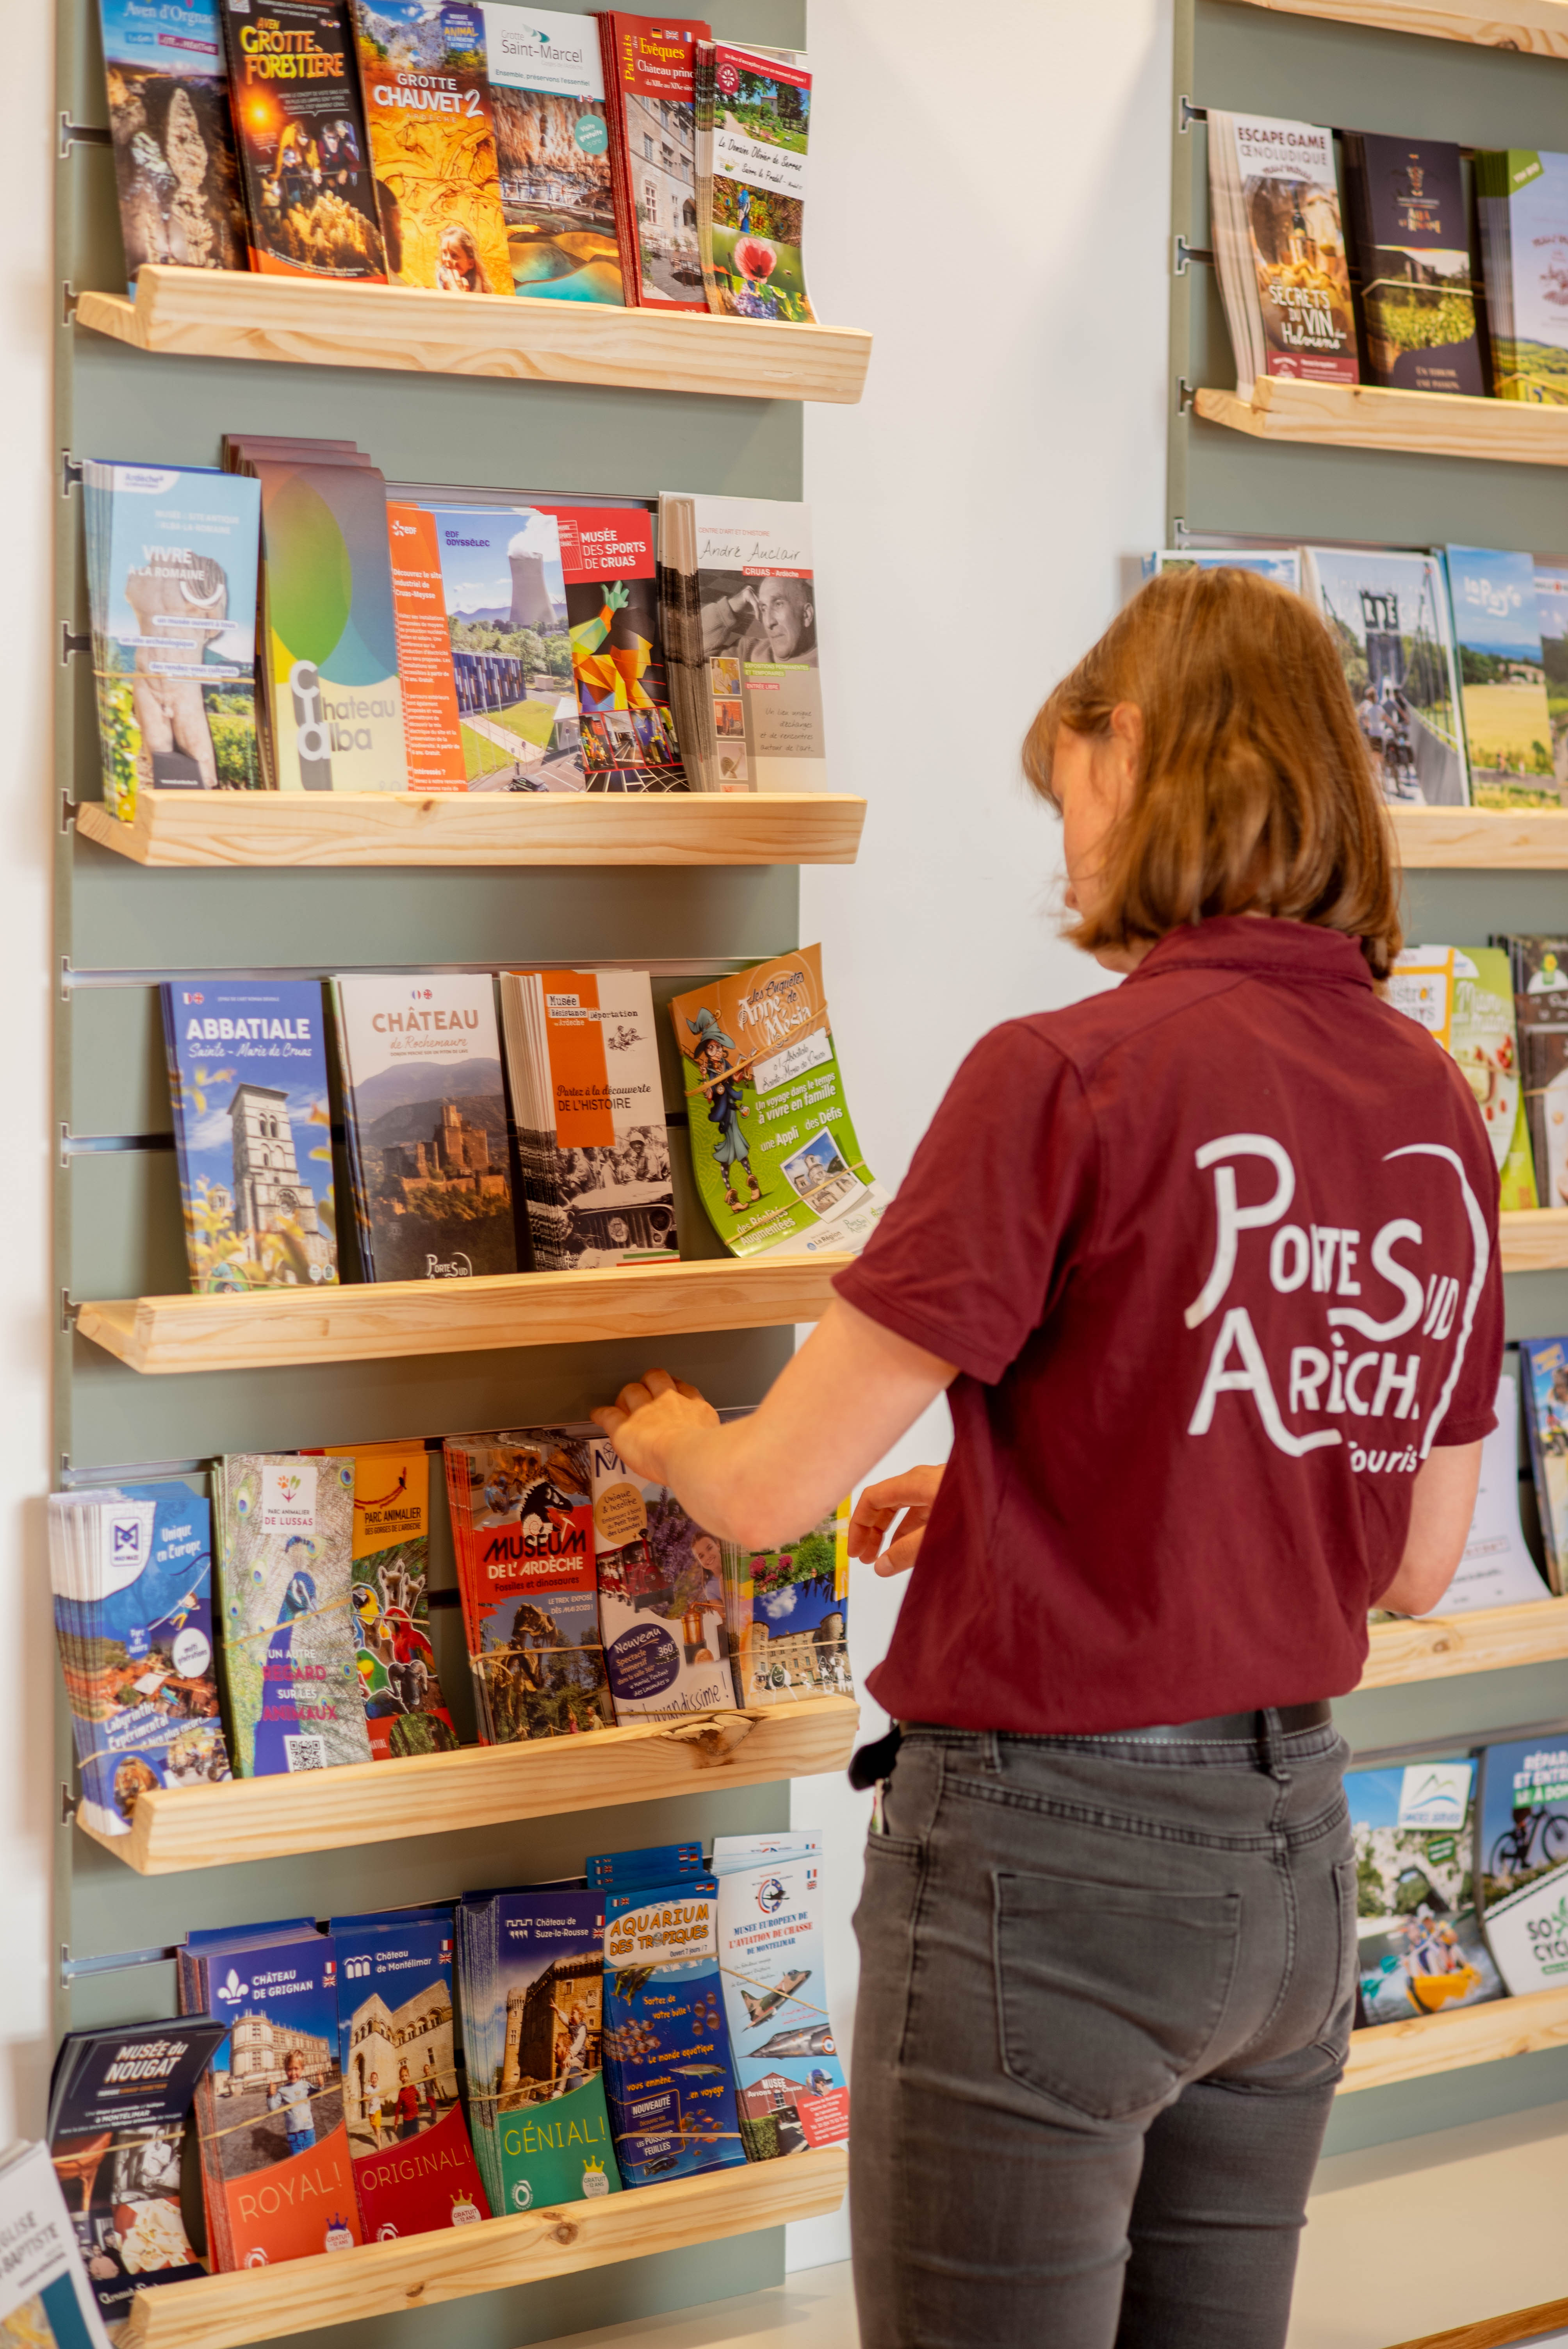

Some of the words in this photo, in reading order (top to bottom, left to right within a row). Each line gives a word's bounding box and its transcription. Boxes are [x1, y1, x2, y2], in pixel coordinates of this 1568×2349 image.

[123, 1, 156, 18] Aven
[160, 4, 214, 27] d'Orgnac
[256, 17, 281, 30] AVEN
[444, 27, 479, 37] ANIMAL
[240, 25, 316, 53] GROTTE
[501, 29, 525, 41] Grotte
[502, 39, 583, 63] Saint-Marcel
[622, 33, 635, 82] Palais
[495, 69, 525, 79] Ensemble,
[526, 73, 560, 83] préservons
[561, 77, 591, 87] l'essentiel
[636, 59, 672, 76] Château
[672, 66, 695, 79] princ
[397, 73, 457, 90] GROTTE
[374, 85, 463, 113] CHAUVET
[465, 89, 485, 118] 2
[579, 130, 604, 143] gratuite
[580, 123, 596, 132] Visite
[1238, 127, 1285, 145] ESCAPE
[1286, 132, 1326, 149] GAME
[718, 136, 725, 147] Le
[728, 139, 749, 156] Domaine
[751, 146, 771, 162] Olivier
[772, 154, 779, 164] de
[781, 156, 803, 171] Serres
[1269, 284, 1331, 310] SECRETS
[1301, 308, 1334, 338] VIN
[580, 527, 618, 543] MUSÉE
[142, 544, 192, 565] VIVRE
[582, 544, 604, 556] DES
[605, 541, 647, 554] SPORTS
[697, 539, 741, 560] André
[746, 542, 802, 562] Auclair
[584, 558, 599, 569] DE
[600, 555, 636, 568] CRUAS
[138, 566, 152, 577] LA
[155, 566, 205, 581] ROMAINE
[393, 569, 422, 578] Découvrez
[430, 571, 442, 579] site
[745, 568, 771, 577] CRUAS
[775, 569, 799, 578] Ardèche
[394, 579, 421, 588] industriel
[395, 589, 436, 599] Cruas-Meysse
[749, 988, 764, 1005] Les
[766, 971, 805, 997] Enquêtes
[786, 989, 798, 1004] de
[550, 995, 577, 1006] Musée
[372, 1006, 480, 1033] CHÂTEAU
[590, 1011, 638, 1020] Déportation
[738, 995, 782, 1032] Anne
[186, 1018, 311, 1041] ABBATIALE
[189, 1042, 225, 1059] Sainte
[236, 1043, 267, 1057] Marie
[269, 1043, 280, 1057] de
[282, 1042, 312, 1057] Cruas
[390, 1037, 401, 1050] de
[403, 1034, 468, 1050] Rochemaure
[558, 1100, 571, 1112] DE
[573, 1098, 632, 1111] L'HISTOIRE
[805, 1115, 819, 1131] des
[819, 1105, 843, 1125] Défis
[740, 1215, 796, 1246] Augmentées
[426, 1254, 451, 1277] PORTE
[444, 1262, 468, 1278] SUD
[604, 1490, 631, 1504] Unique
[265, 1517, 276, 1525] DE
[280, 1517, 313, 1526] LUSSAS
[365, 1512, 382, 1524] PARC
[384, 1507, 421, 1522] ANIMALIER
[614, 1518, 627, 1527] Petit
[628, 1514, 640, 1523] Train
[161, 1524, 192, 1542] Unique
[365, 1527, 374, 1535] DES
[374, 1526, 391, 1534] GORGES
[157, 1550, 168, 1562] en
[168, 1540, 202, 1560] Europe
[487, 1565, 506, 1579] DE
[519, 1555, 583, 1576] ARDÈCHE
[494, 1581, 525, 1592] Fossiles
[526, 1580, 535, 1589] et
[536, 1576, 580, 1589] dinosaures
[130, 1628, 145, 1637] Parc
[613, 1628, 661, 1654] Nouveau
[128, 1643, 149, 1654] loisirs
[268, 1649, 283, 1659] UN
[286, 1649, 317, 1659] AUTRE
[615, 1649, 647, 1667] Spectacle
[619, 1657, 647, 1675] immersif
[262, 1664, 327, 1682] REGARD
[104, 1702, 156, 1734] Labyrinthe
[262, 1705, 338, 1722] ANIMAUX
[107, 1712, 169, 1751] Expérimental
[1524, 1750, 1568, 1770] RÉPAR
[1513, 1773, 1531, 1788] ET
[1533, 1770, 1568, 1786] ENTR
[535, 1918, 566, 1927] Château
[567, 1917, 576, 1925] de
[610, 1903, 709, 1937] AQUARIUM
[734, 1923, 757, 1937] MUSEE
[759, 1914, 797, 1930] EUROPEEN
[798, 1912, 808, 1921] DE
[535, 1928, 589, 1939] Suze-la-Rousse
[729, 1930, 771, 1950] L'AVIATION
[773, 1928, 782, 1937] DE
[783, 1921, 814, 1936] CHASSE
[1528, 1919, 1553, 1940] SO
[376, 1951, 409, 1962] Château
[1533, 1943, 1568, 1962] CYCL
[377, 1964, 386, 1973] de
[388, 1958, 432, 1972] Montélimar
[252, 1970, 297, 1986] CHÂTEAU
[253, 1988, 266, 2000] DE
[268, 1980, 314, 1997] GRIGNAN
[642, 1996, 666, 2006] Sortez
[667, 1994, 676, 2004] de
[116, 2039, 171, 2062] MUSÉE
[167, 2040, 189, 2056] du
[648, 2055, 657, 2064] Le
[658, 2051, 680, 2063] monde
[682, 2043, 714, 2059] aquatique
[104, 2056, 182, 2084] NOUGAT
[761, 2078, 787, 2090] MUSEE
[632, 2094, 672, 2116] NOUVEAUTÉ
[102, 2110, 151, 2123] MONTÉLIMAR
[504, 2119, 599, 2156] GÉNIAL
[599, 2116, 606, 2140] !
[362, 2151, 465, 2191] ORIGINAL
[463, 2144, 472, 2163] !
[584, 2176, 606, 2184] GRATUIT
[237, 2168, 335, 2223] ROYAL
[333, 2162, 343, 2187] !
[453, 2208, 478, 2219] GRATUIT
[0, 2210, 37, 2249] GLISE
[326, 2233, 351, 2243] GRATUIT
